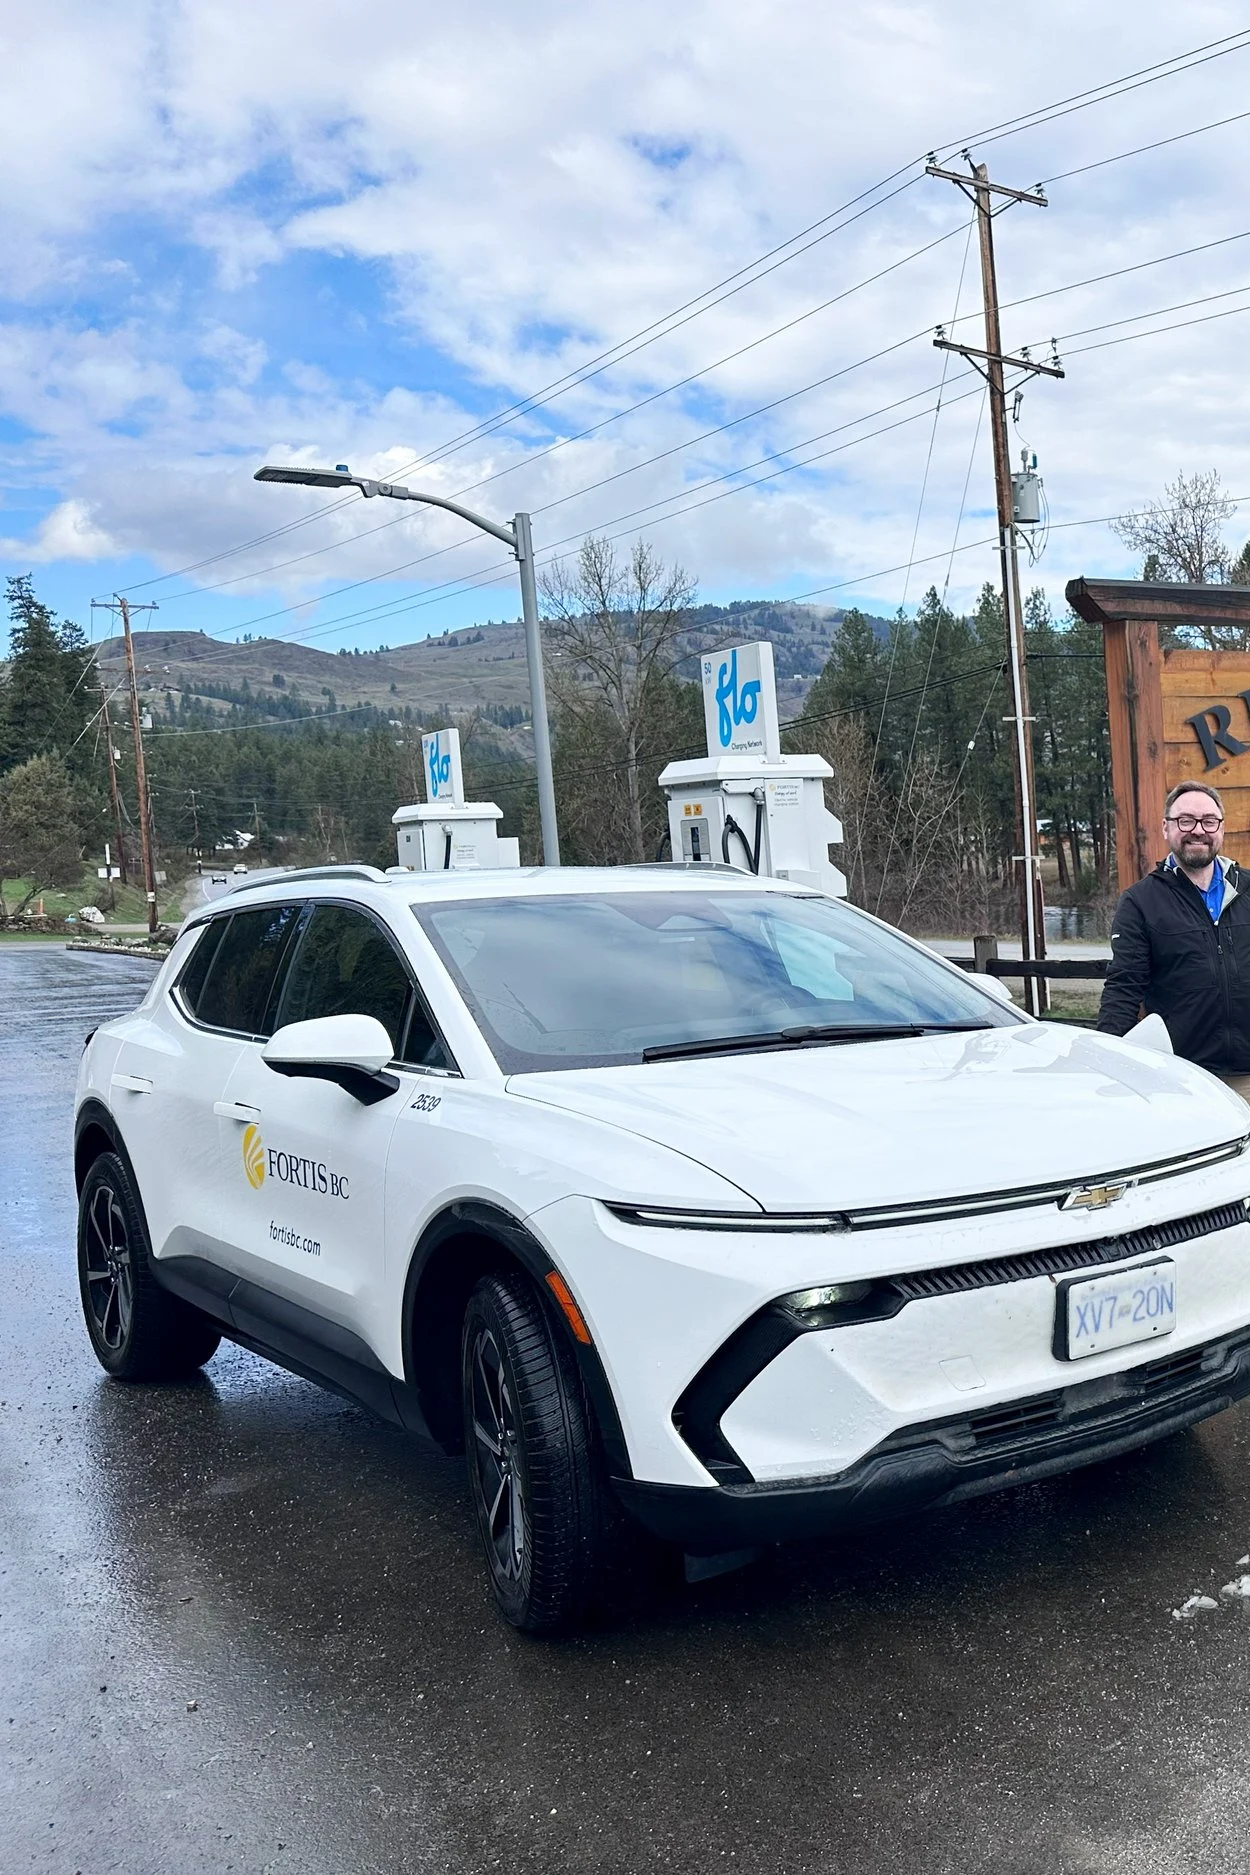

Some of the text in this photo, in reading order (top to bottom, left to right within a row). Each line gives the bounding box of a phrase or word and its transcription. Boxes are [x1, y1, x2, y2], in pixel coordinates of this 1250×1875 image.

[716, 649, 761, 748] flo
[430, 733, 451, 797] flo
[410, 1093, 442, 1112] 2539
[269, 1220, 321, 1256] fortisbc.com
